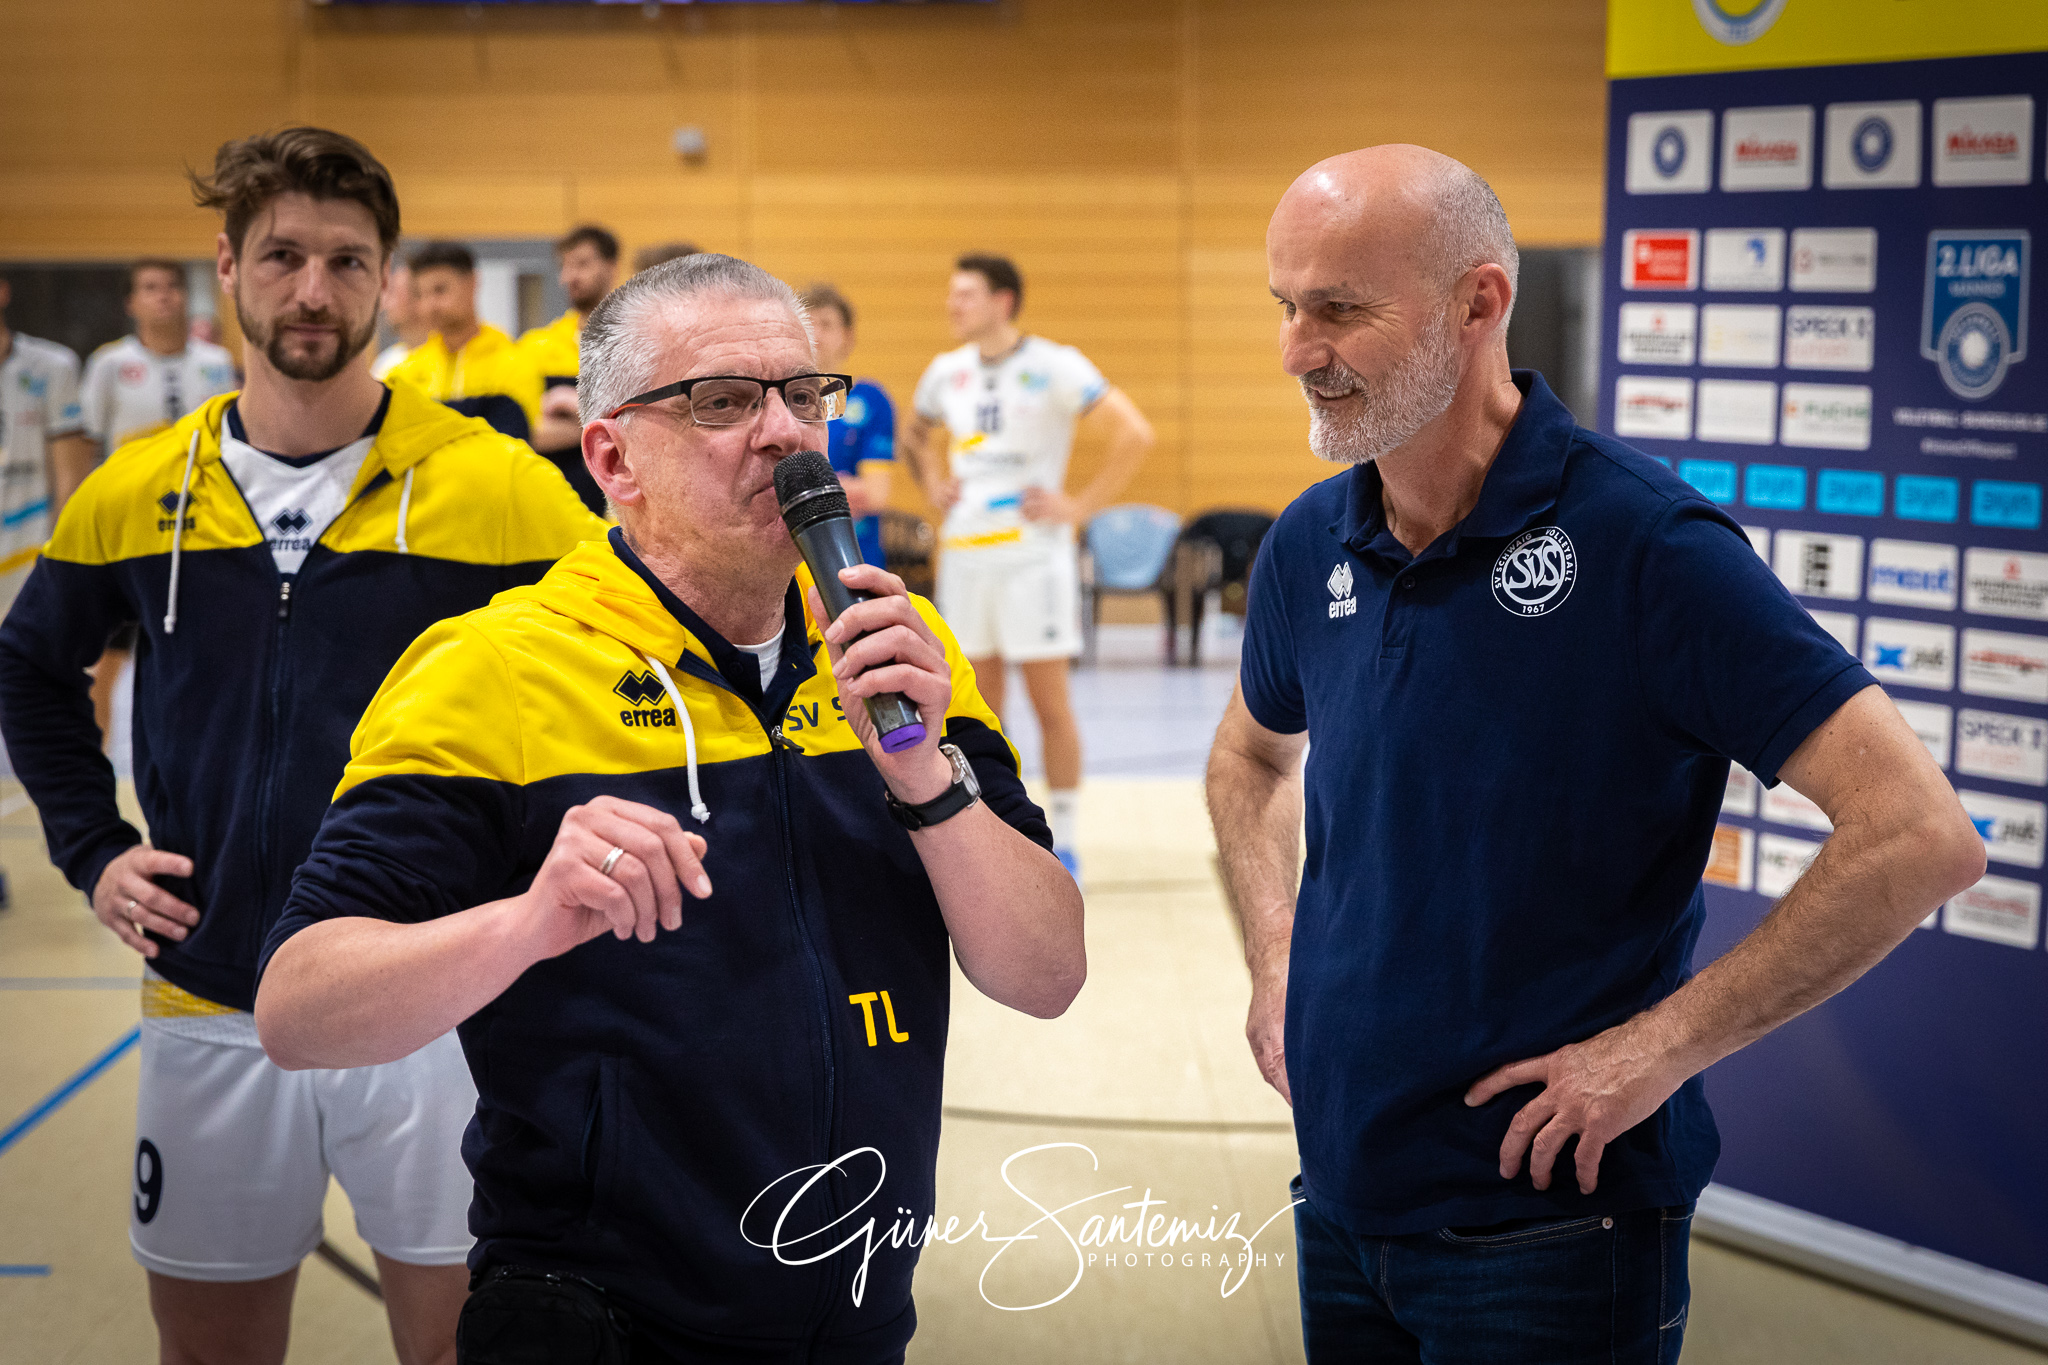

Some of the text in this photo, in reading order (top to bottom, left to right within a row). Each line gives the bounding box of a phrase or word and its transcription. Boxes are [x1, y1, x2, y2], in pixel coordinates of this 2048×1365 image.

[1496, 533, 1532, 573] SCHWAIG
[1545, 529, 1574, 582] VOLLEYBALL
[1328, 596, 1357, 619] errea
[1522, 604, 1545, 614] 1967
[620, 707, 676, 727] errea
[785, 701, 819, 731] SV
[849, 990, 909, 1047] TL
[136, 1138, 163, 1225] 9
